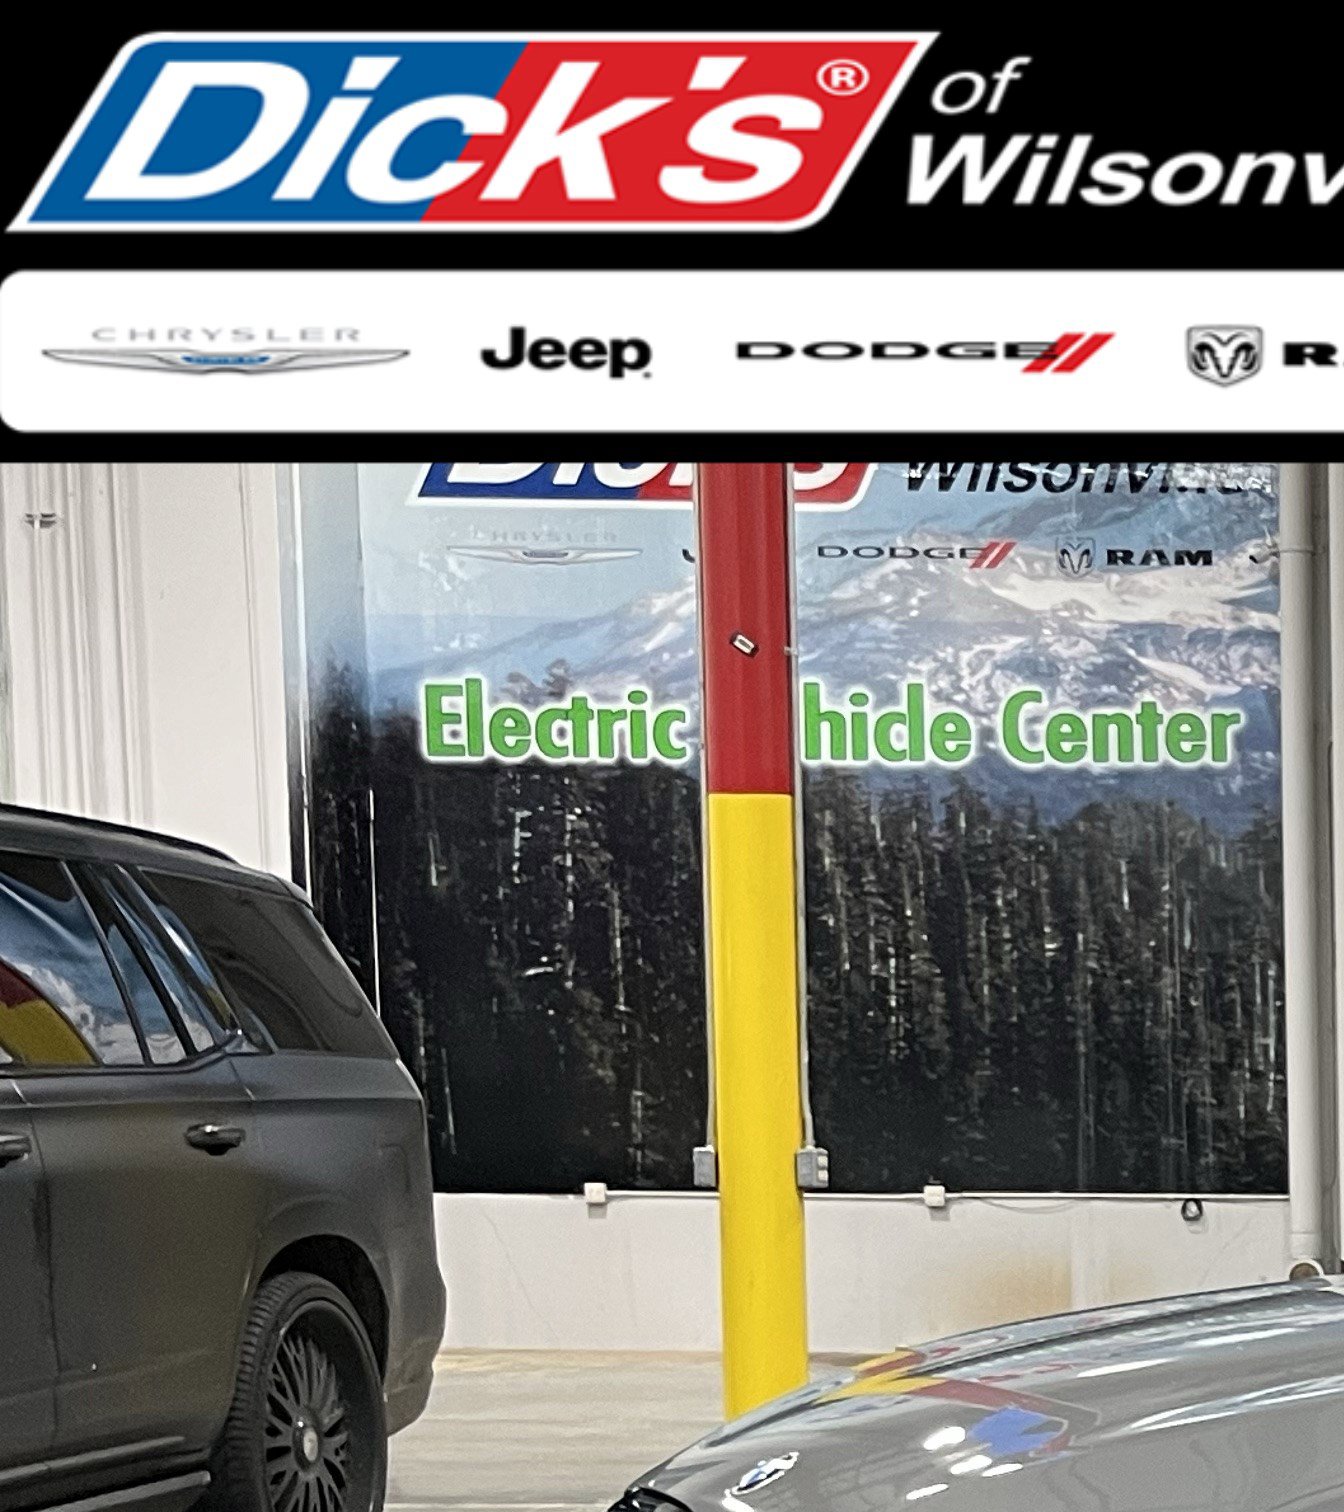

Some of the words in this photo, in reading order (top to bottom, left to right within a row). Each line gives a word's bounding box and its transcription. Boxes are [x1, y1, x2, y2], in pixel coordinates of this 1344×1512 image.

[906, 462, 1244, 494] Wilsonv
[472, 529, 619, 543] HRYSLER
[816, 544, 985, 560] DODGE
[1105, 549, 1215, 567] RAM
[424, 677, 687, 759] Electric
[803, 682, 973, 763] hicle
[1002, 690, 1242, 764] Center
